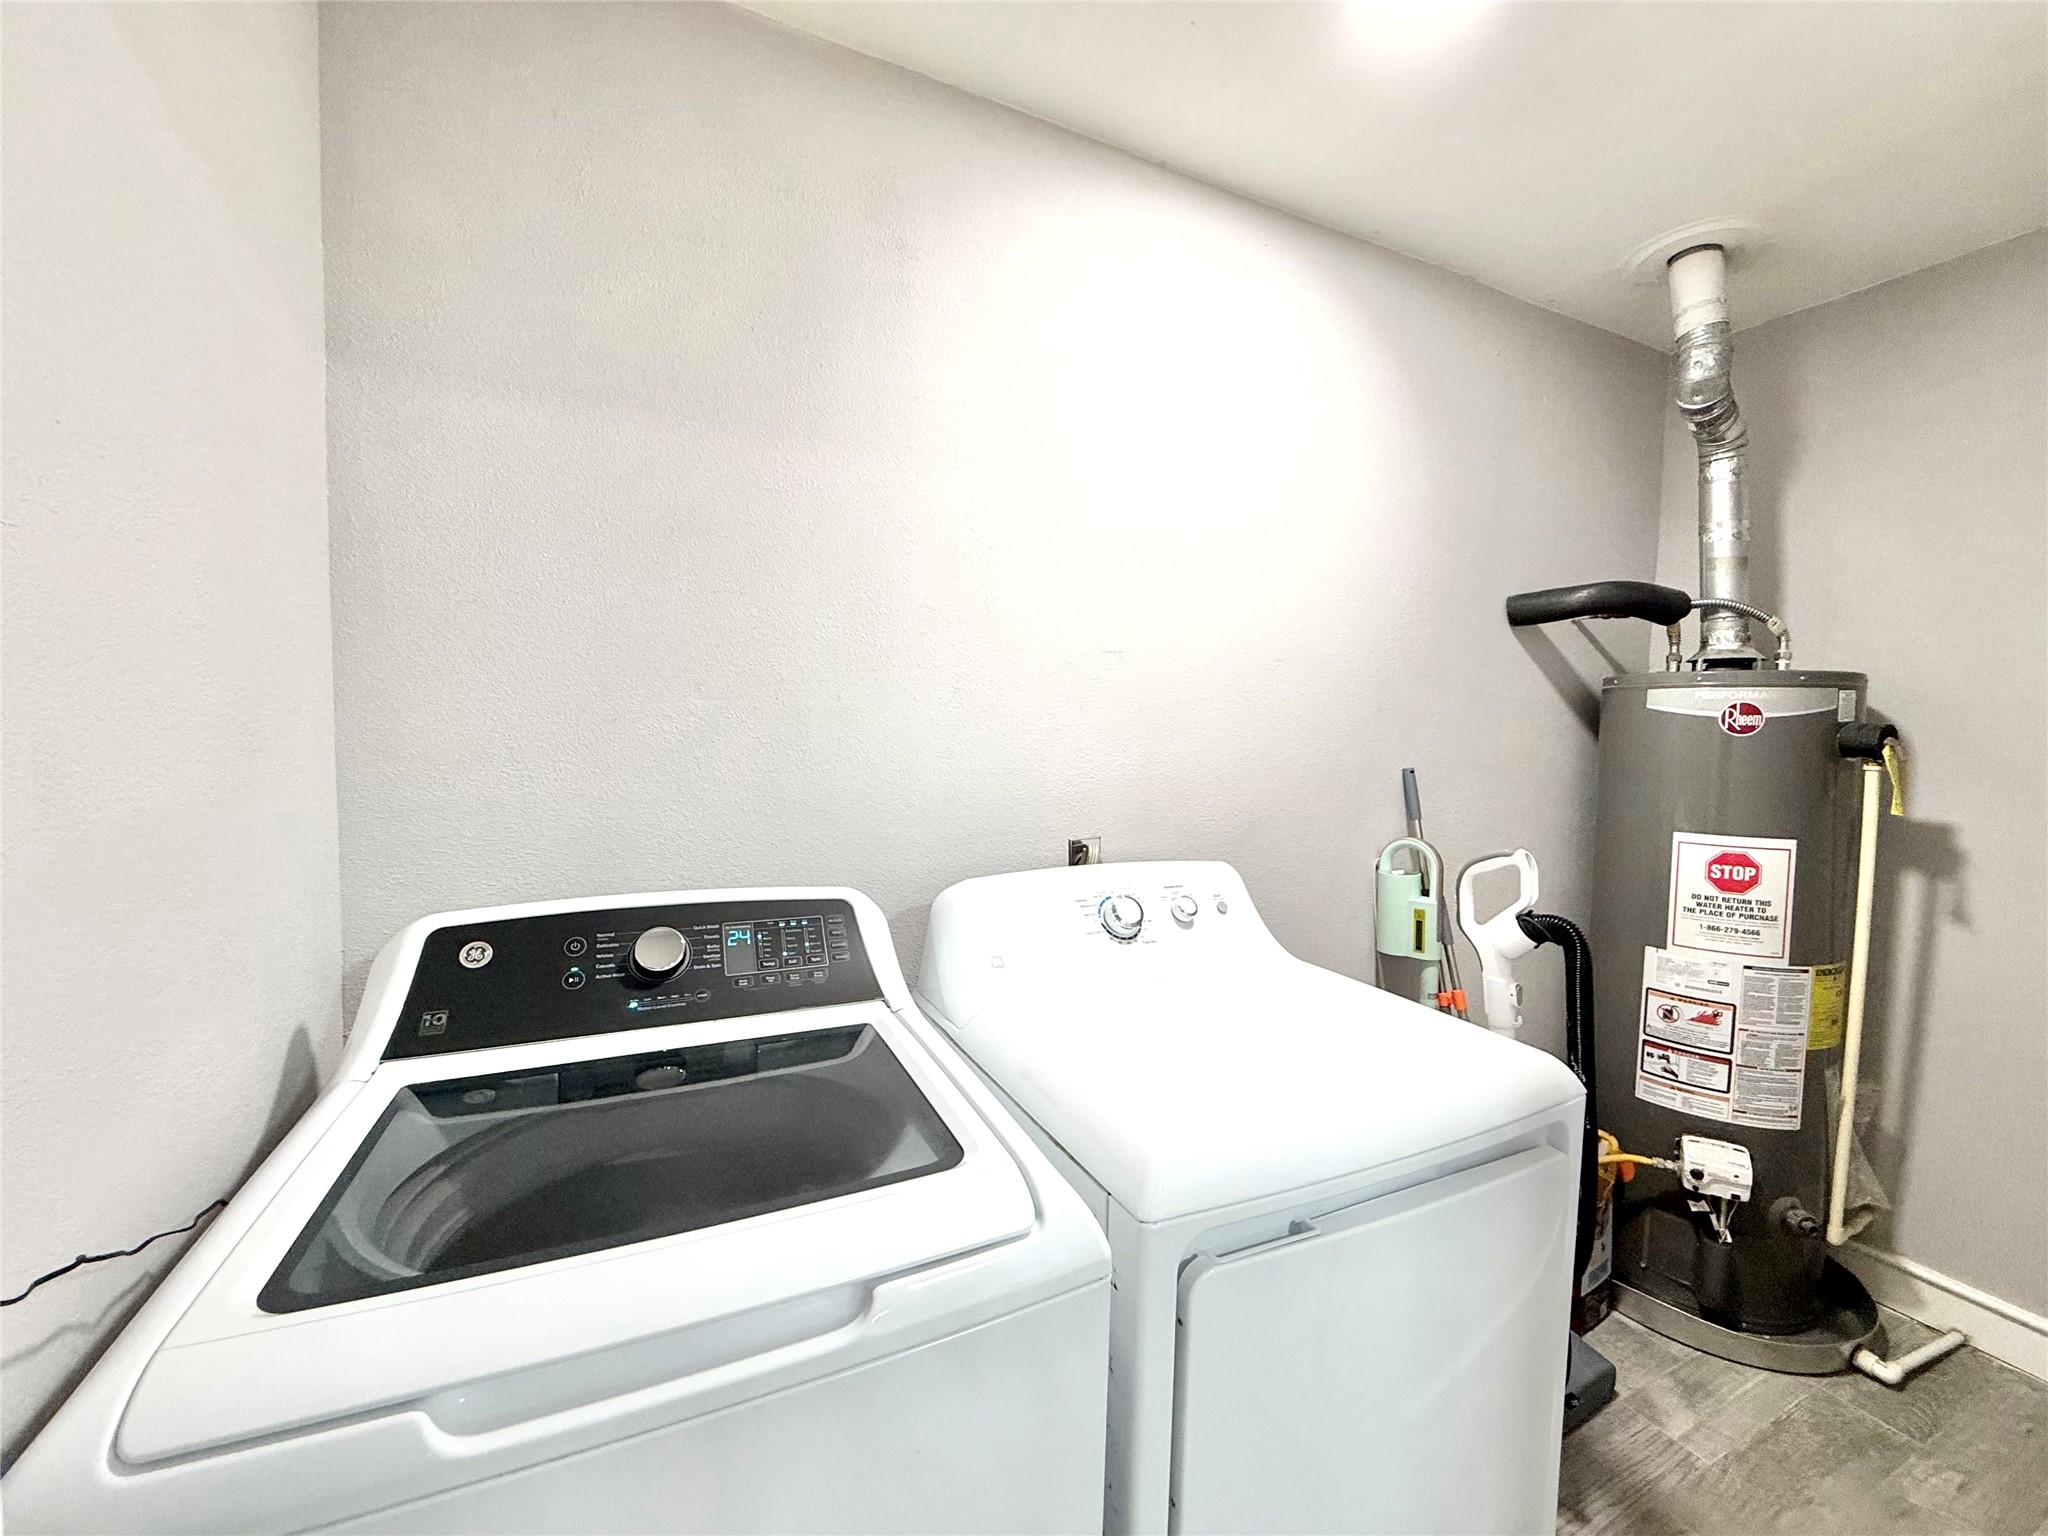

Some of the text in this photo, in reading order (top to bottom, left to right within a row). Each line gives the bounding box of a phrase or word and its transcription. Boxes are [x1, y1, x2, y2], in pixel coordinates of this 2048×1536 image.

[1724, 702, 1762, 730] Rheem
[1710, 864, 1757, 881] STOP
[1695, 901, 1722, 910] WATER
[1724, 904, 1755, 914] HEATER
[1704, 895, 1719, 903] NOT
[1721, 897, 1752, 906] RETURN
[1755, 899, 1772, 907] THIS
[1682, 906, 1697, 914] THE
[1699, 908, 1724, 917] PLACE
[1726, 911, 1736, 919] OF
[1738, 913, 1779, 922] PURCHASE
[727, 929, 751, 946] 24
[1699, 923, 1761, 936] 1-866-279-4566
